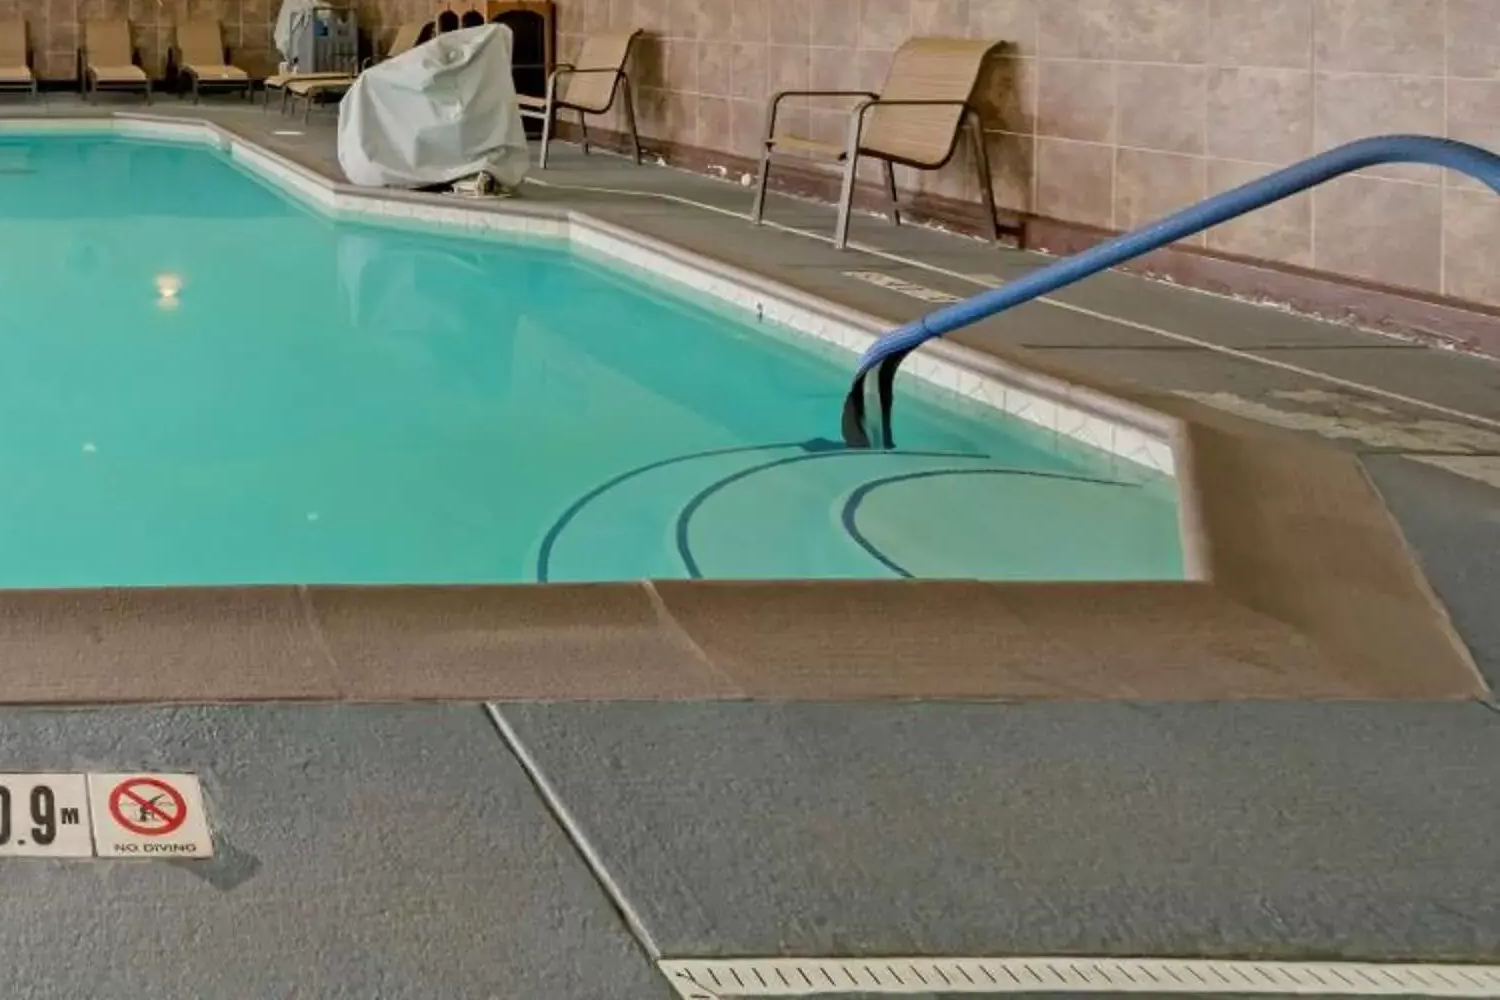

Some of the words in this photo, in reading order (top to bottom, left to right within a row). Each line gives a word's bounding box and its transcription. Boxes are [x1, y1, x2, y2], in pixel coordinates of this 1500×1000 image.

[61, 806, 80, 825] M
[113, 842, 139, 853] NO
[143, 842, 197, 853] DIVING
